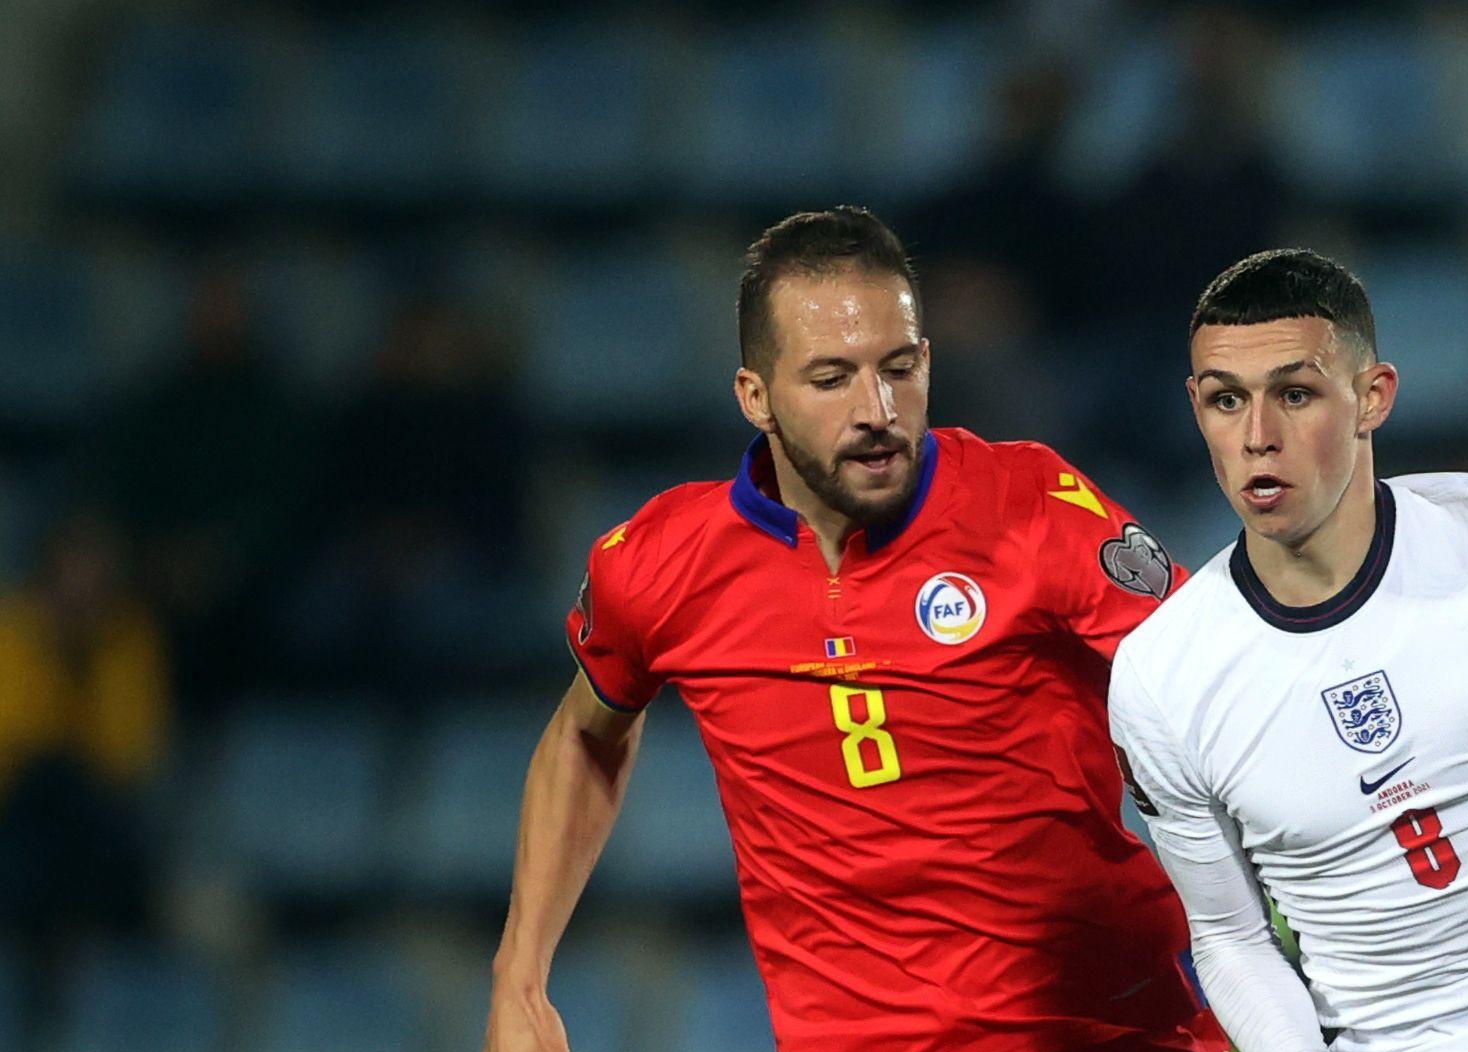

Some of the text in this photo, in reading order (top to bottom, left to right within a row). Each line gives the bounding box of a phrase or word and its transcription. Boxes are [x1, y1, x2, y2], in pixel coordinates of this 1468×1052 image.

[933, 601, 965, 620] FAF
[830, 684, 901, 788] 8
[1376, 791, 1413, 811] OCTOBER
[1412, 782, 1431, 795] 2021
[1377, 779, 1415, 800] ANDORRA
[1390, 807, 1461, 890] 8
